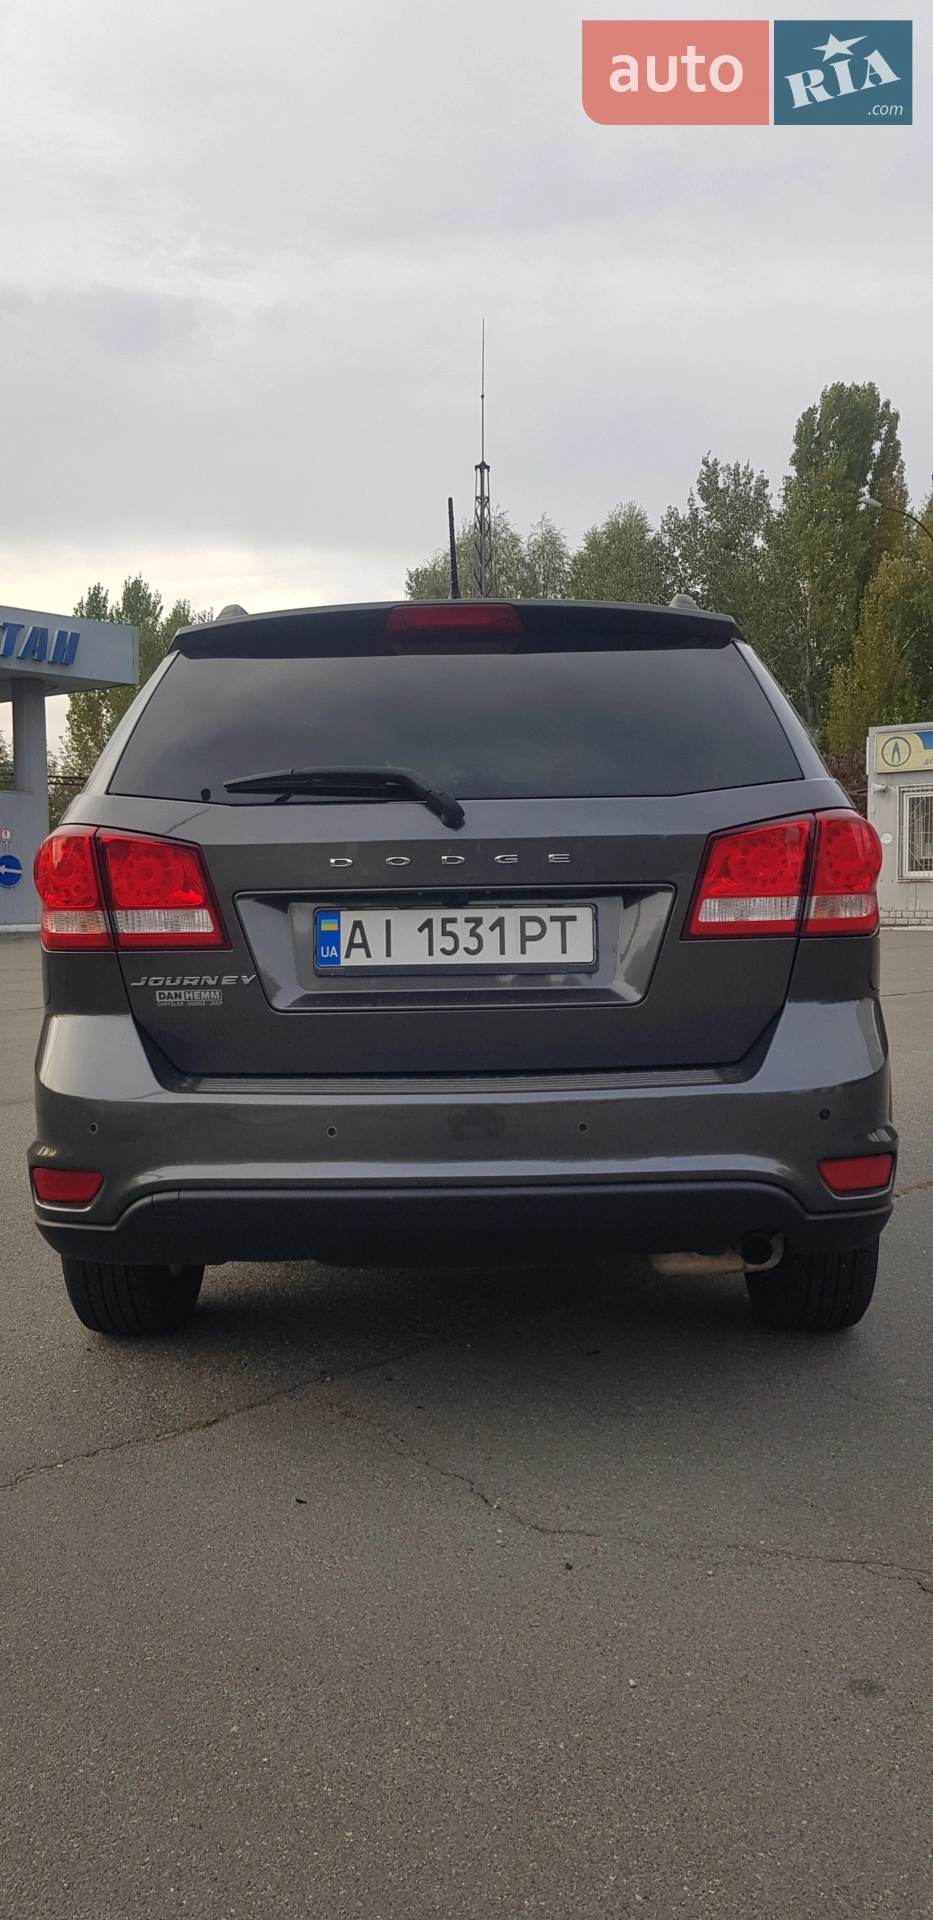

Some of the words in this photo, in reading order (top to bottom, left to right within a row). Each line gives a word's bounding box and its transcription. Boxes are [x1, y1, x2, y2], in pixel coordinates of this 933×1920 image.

[329, 853, 571, 868] DODGE
[320, 945, 339, 959] UA
[130, 974, 257, 987] JOURNEY
